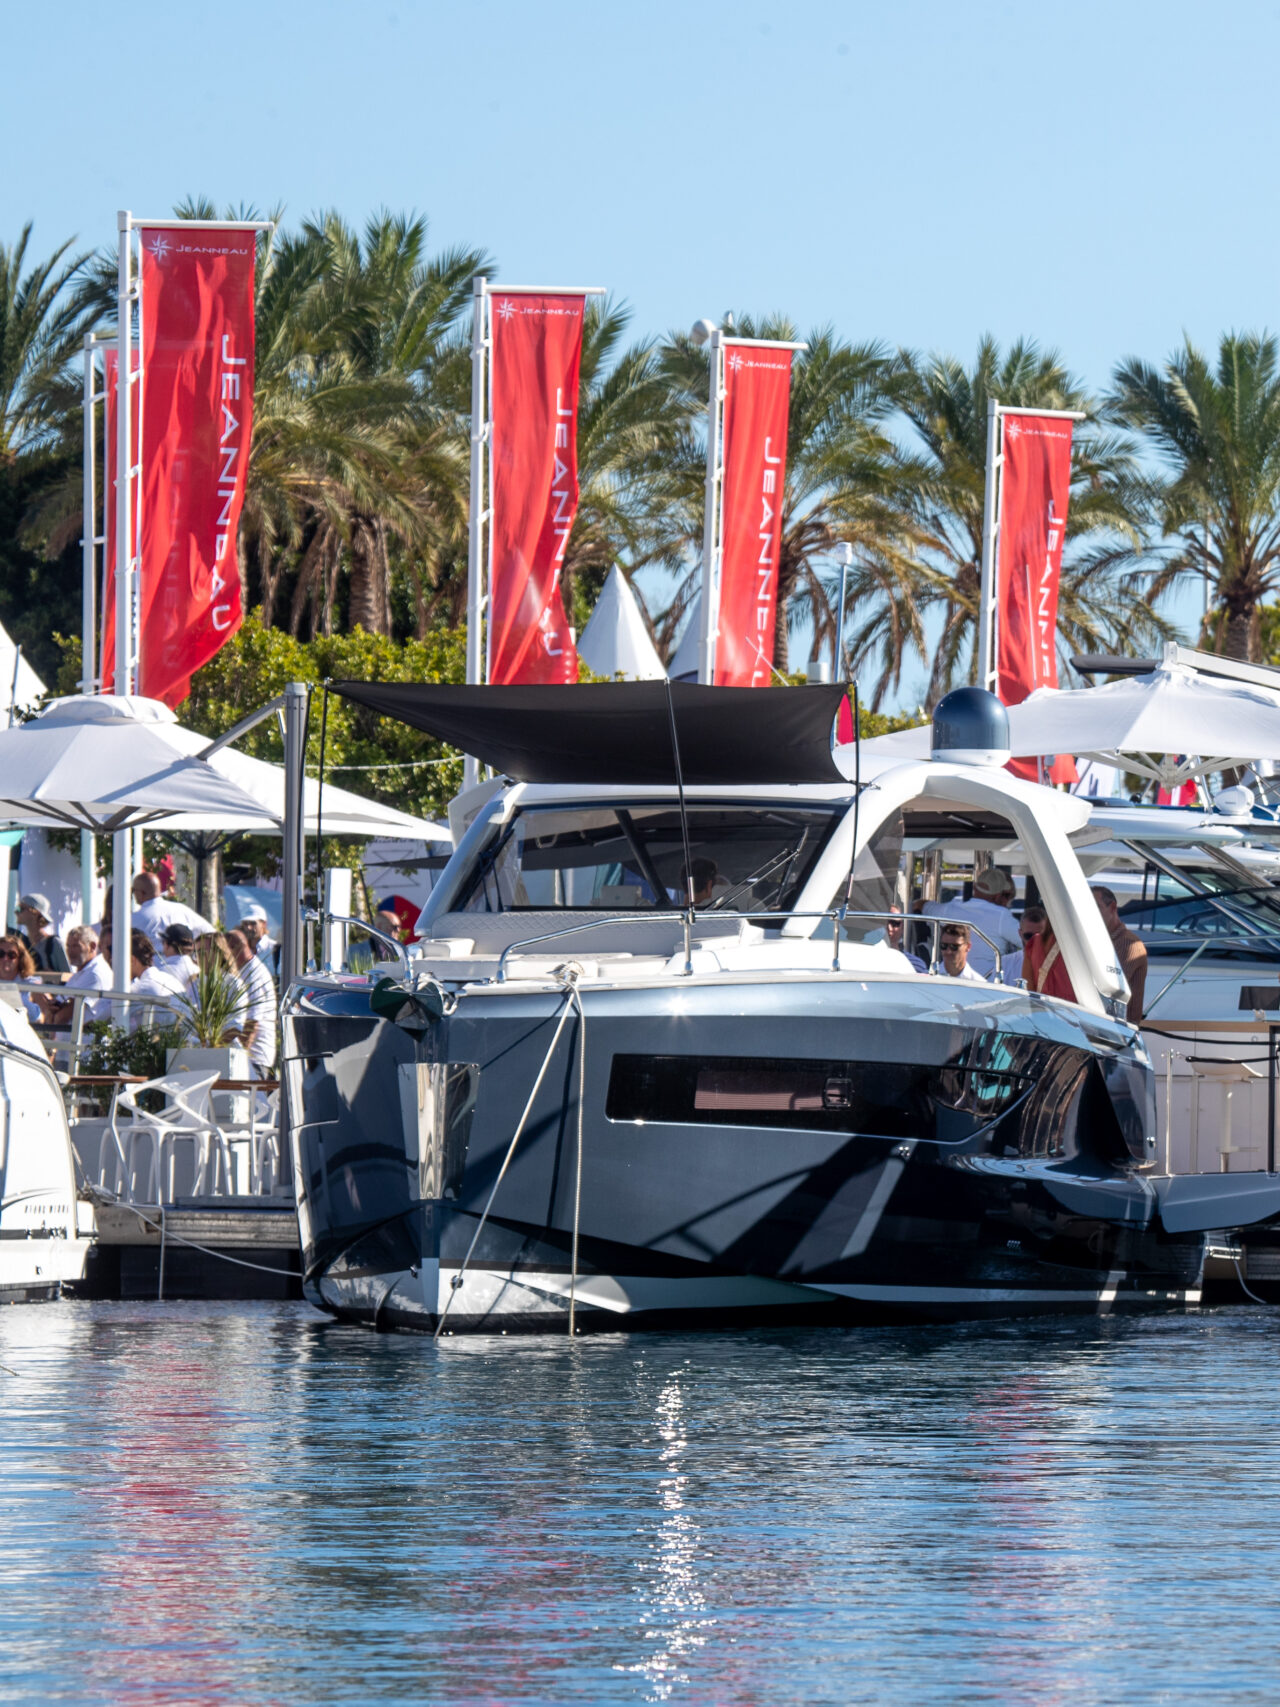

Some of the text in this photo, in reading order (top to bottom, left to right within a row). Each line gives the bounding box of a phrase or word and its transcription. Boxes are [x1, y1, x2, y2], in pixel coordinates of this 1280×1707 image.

[175, 244, 248, 255] JEANNEAU
[520, 307, 579, 316] JEANNEAU
[210, 334, 247, 631] JEANNEAU
